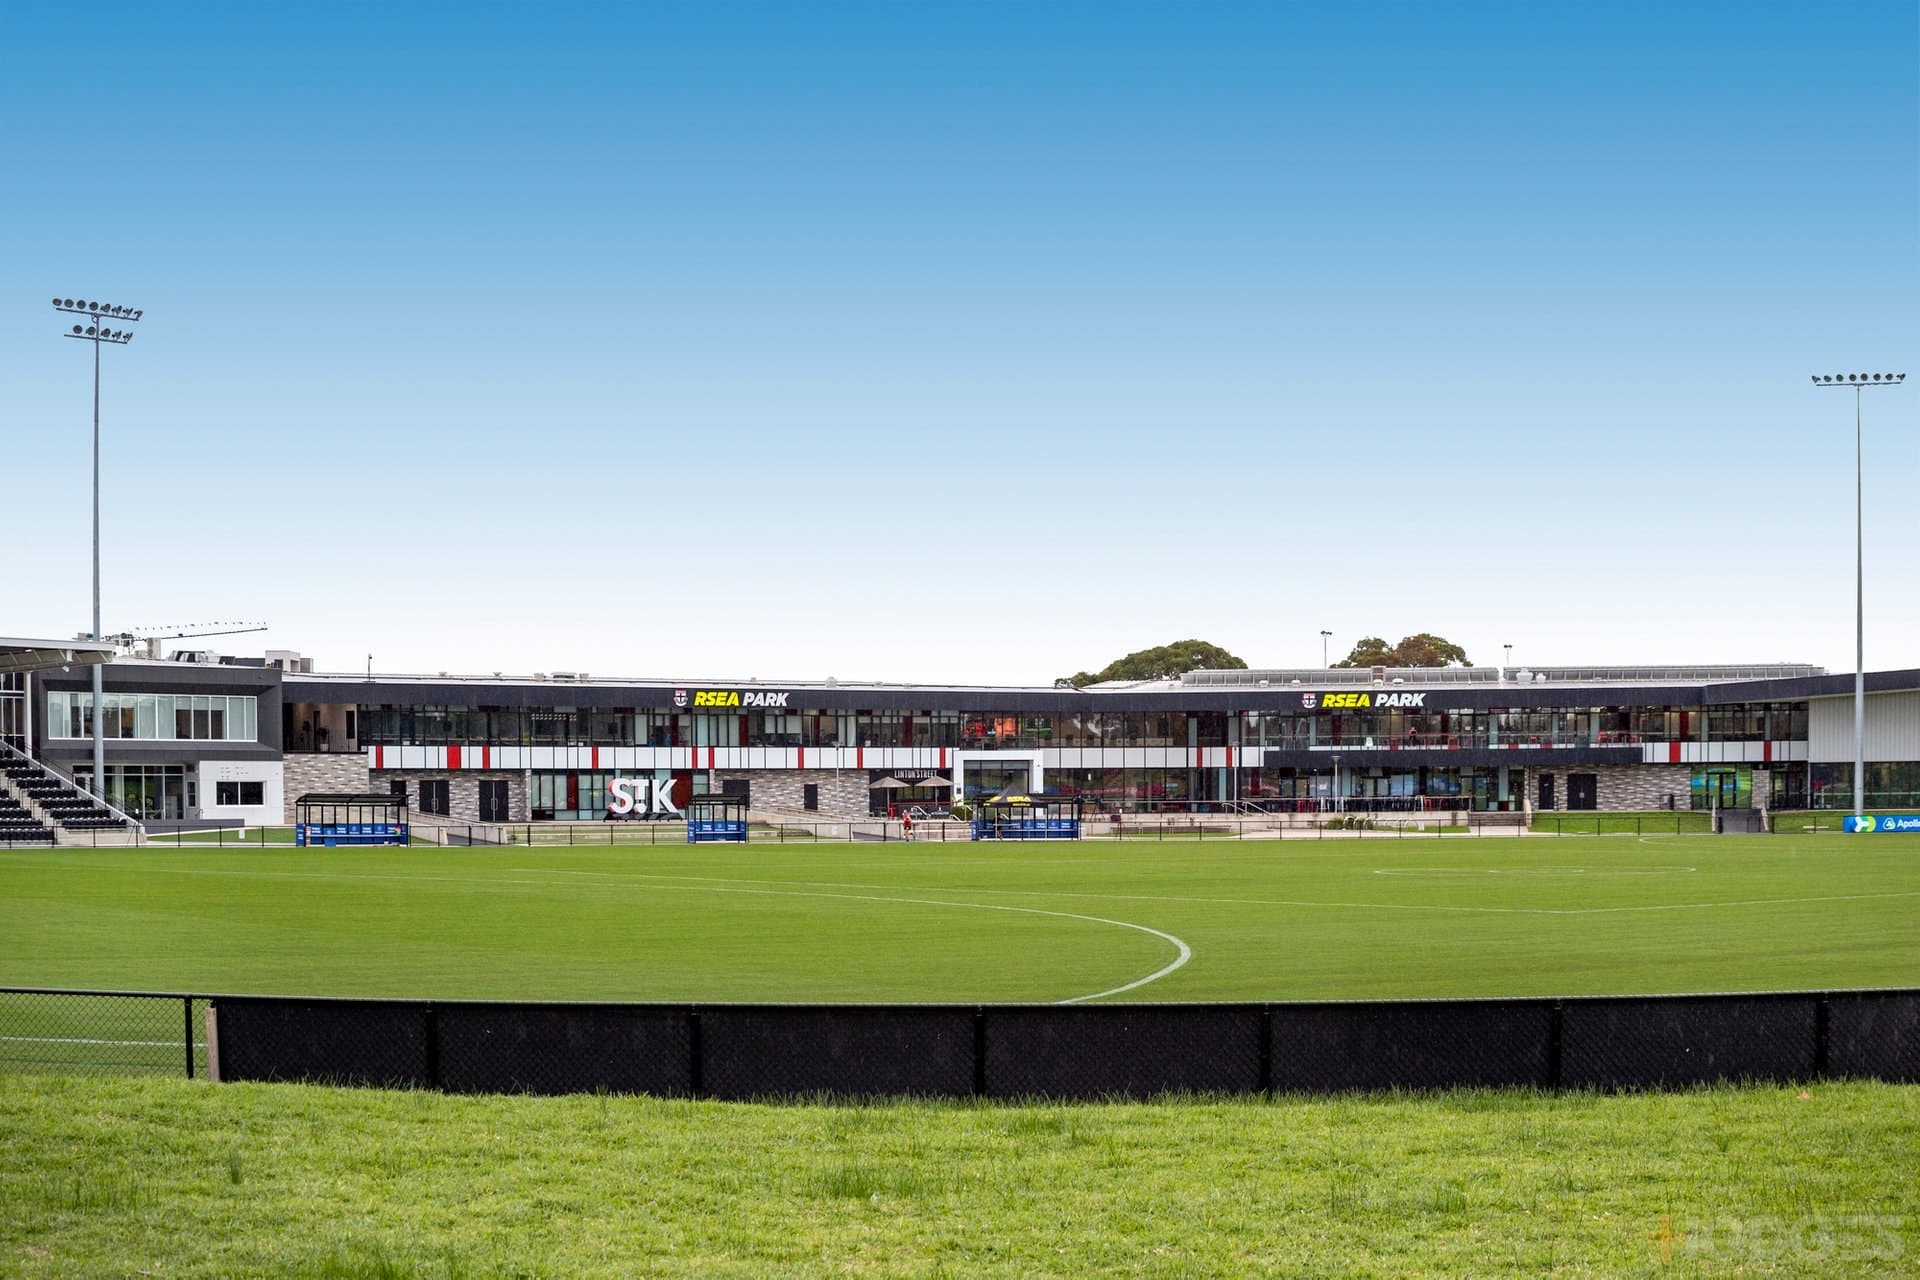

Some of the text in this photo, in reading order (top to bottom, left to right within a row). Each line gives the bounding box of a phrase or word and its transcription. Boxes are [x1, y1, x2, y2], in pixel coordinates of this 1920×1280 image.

[694, 691, 790, 707] RSEA PARK
[1321, 693, 1426, 708] RSEA PARK
[916, 769, 937, 778] STREET
